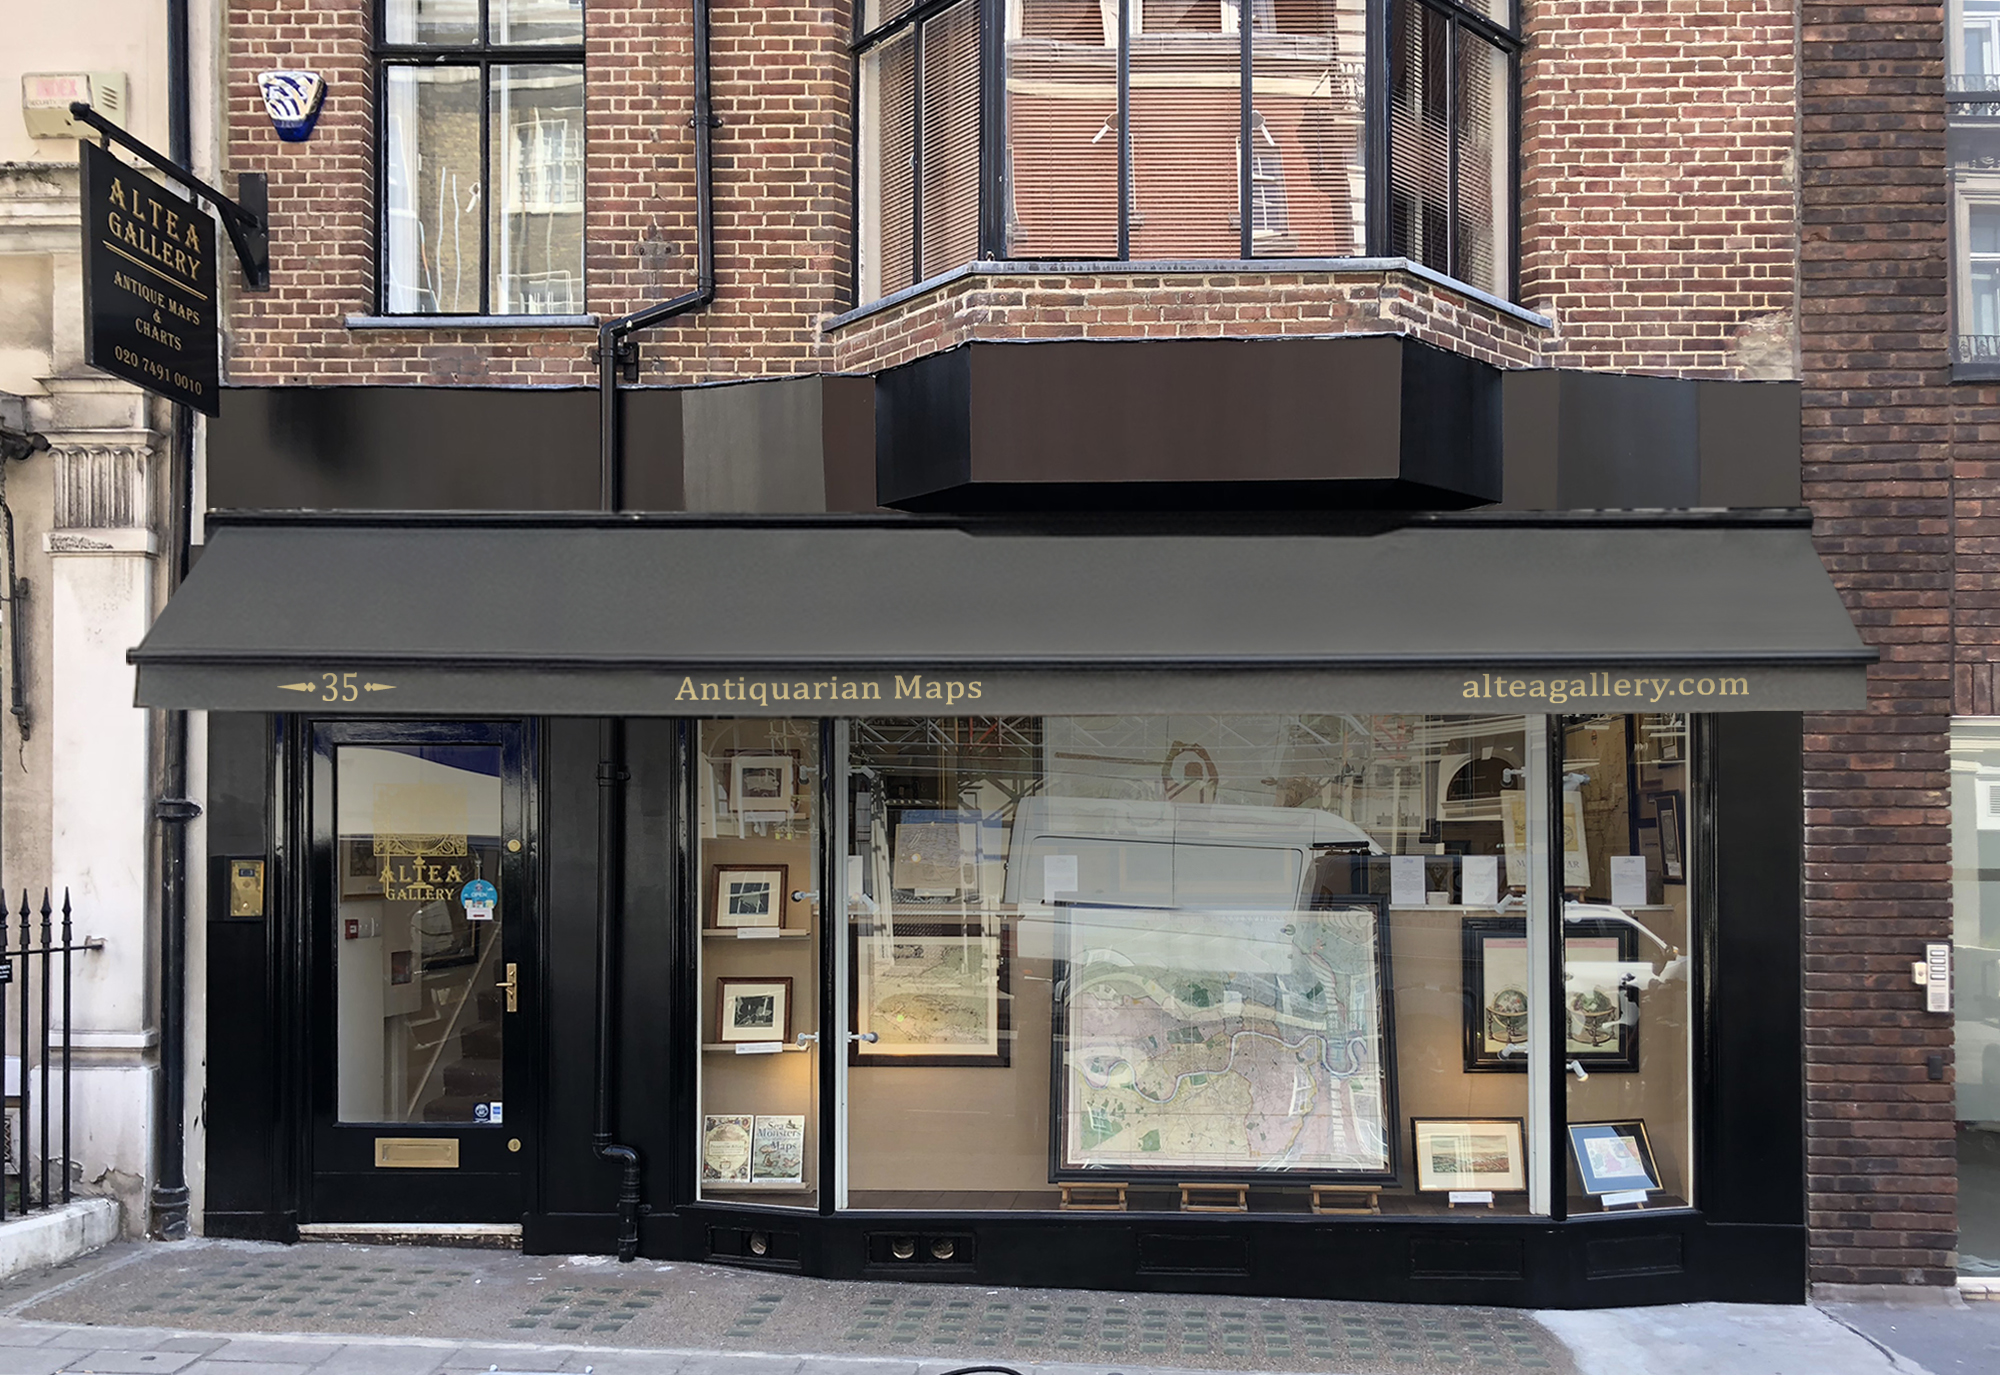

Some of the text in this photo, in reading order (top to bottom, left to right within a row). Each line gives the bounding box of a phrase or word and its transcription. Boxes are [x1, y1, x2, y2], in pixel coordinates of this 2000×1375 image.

[109, 177, 201, 254] ALTEA
[108, 211, 201, 281] GALLERY
[114, 271, 200, 326] ANTIQUE MAPS
[152, 308, 162, 324] &
[135, 317, 182, 351] CHARTS
[114, 345, 202, 396] 020 7491 0010
[321, 672, 359, 702] 35
[674, 674, 983, 707] Antiquarian Maps
[1462, 671, 1750, 704] alteagallery.com
[378, 864, 464, 883] ALTEA
[386, 888, 455, 901] GALLERY
[767, 1121, 785, 1130] Sea
[771, 1141, 797, 1152] Maps
